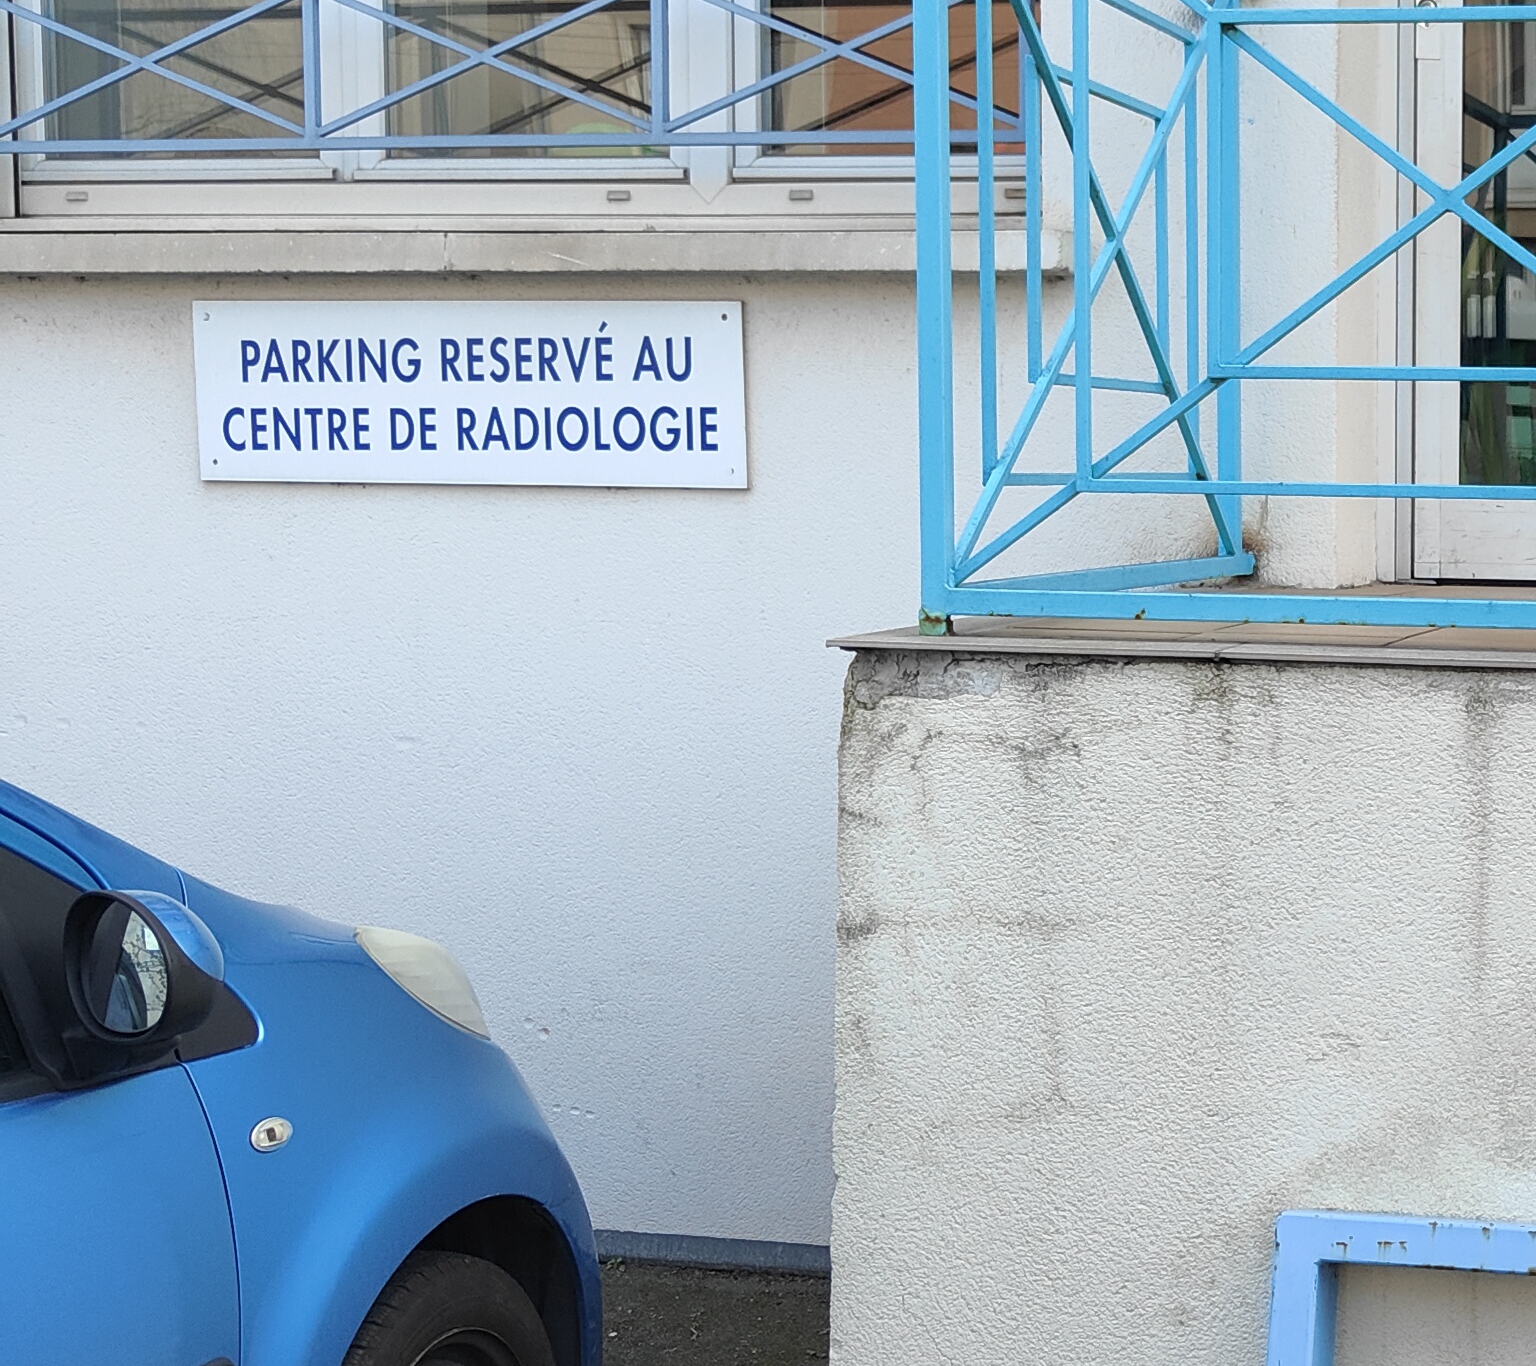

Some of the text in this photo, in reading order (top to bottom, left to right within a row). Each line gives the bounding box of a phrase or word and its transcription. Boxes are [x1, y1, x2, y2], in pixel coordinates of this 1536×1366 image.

[240, 320, 693, 383] PARKING RESERVÉ AU
[222, 405, 719, 453] CENTRE DE RADIOLOGIE
